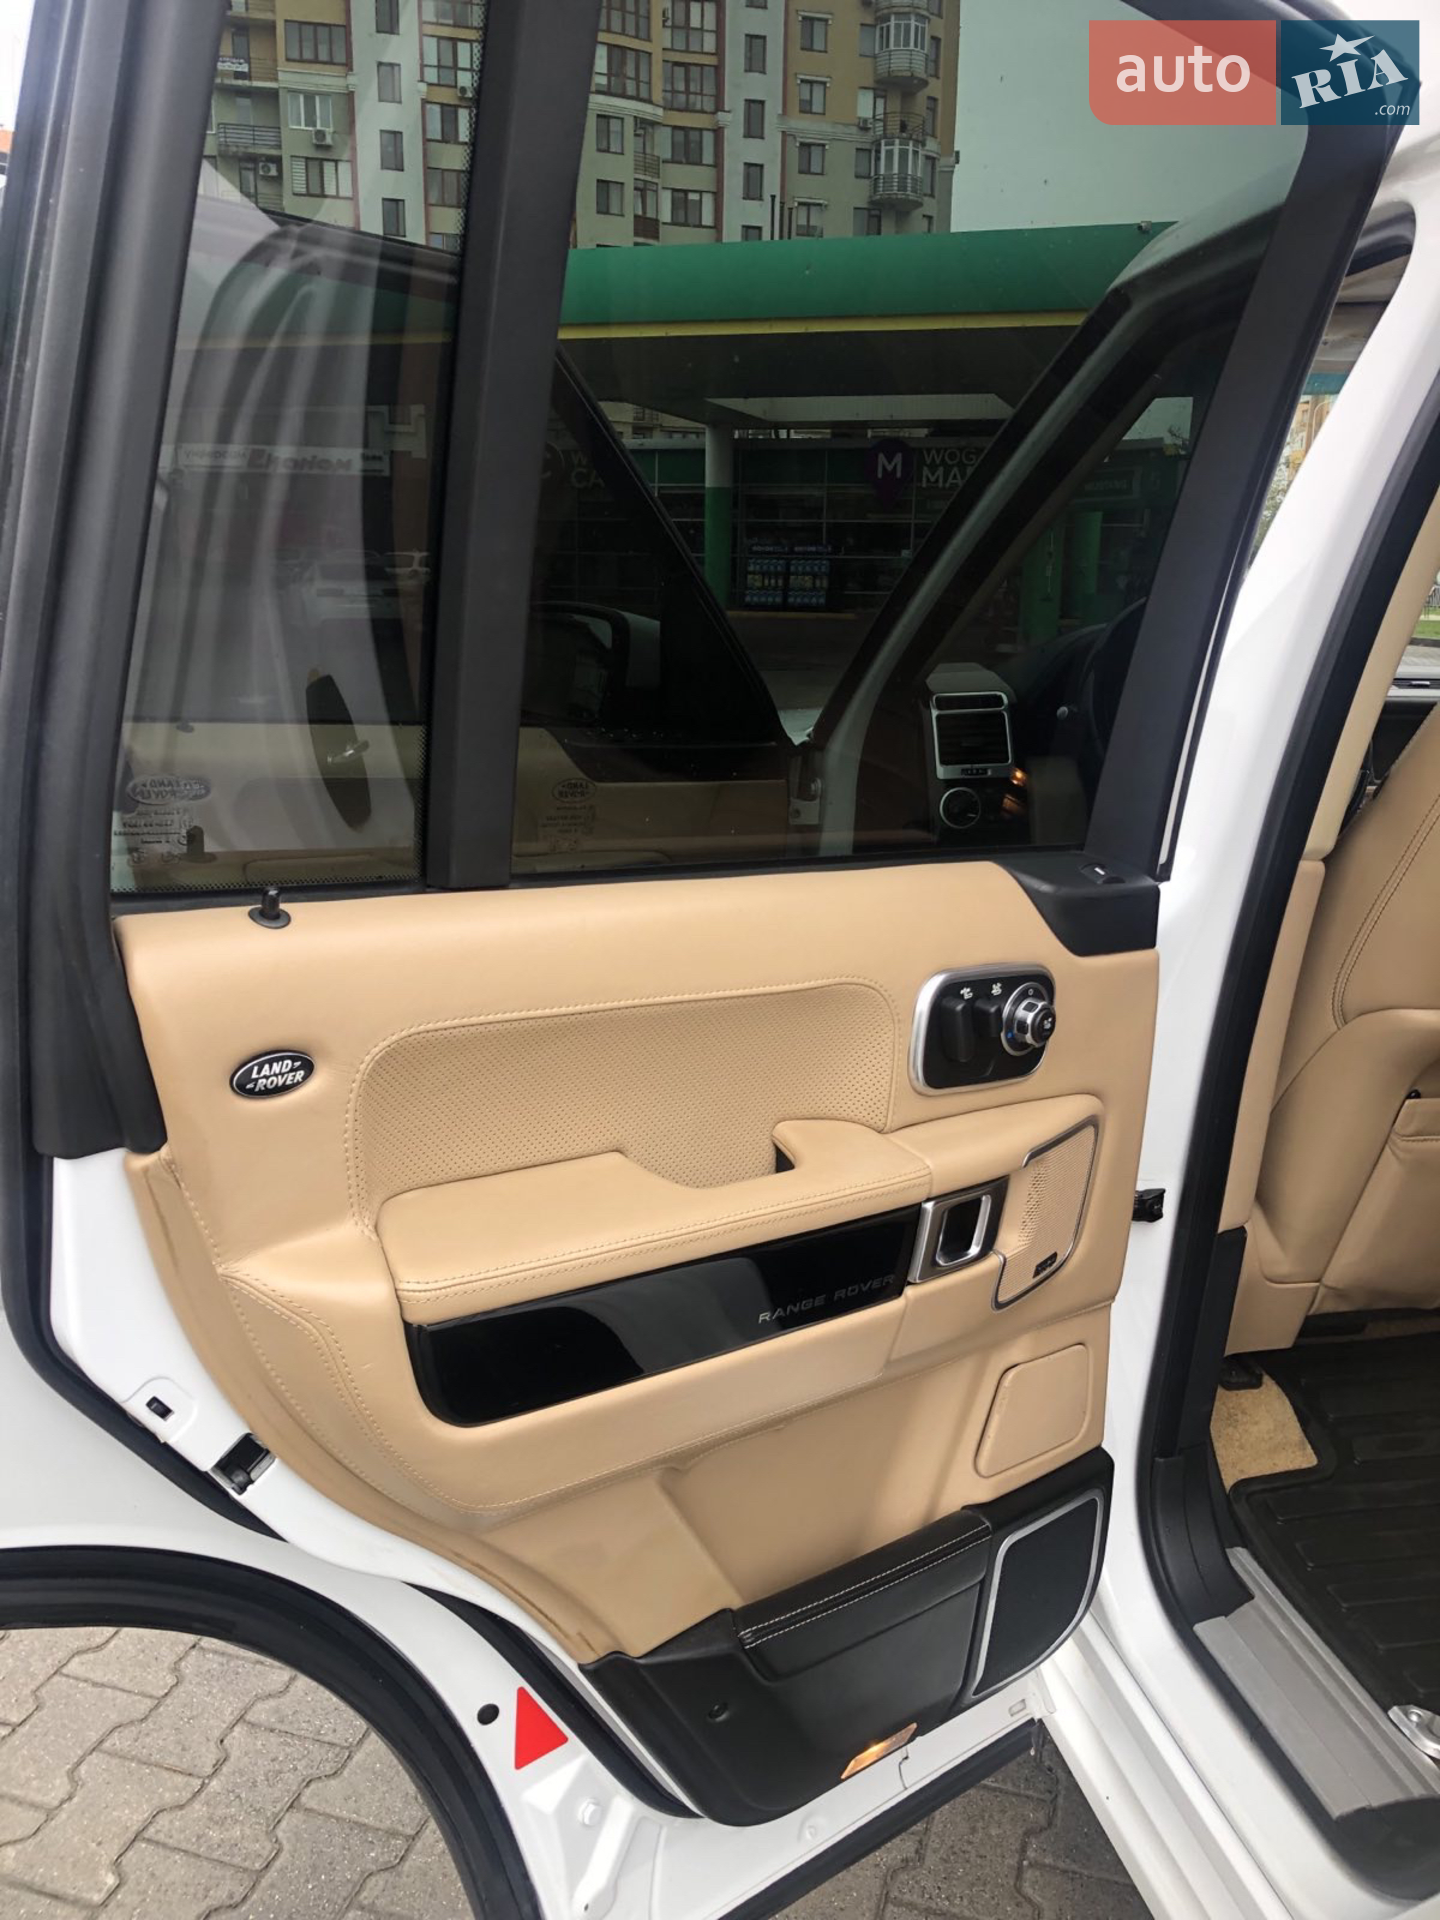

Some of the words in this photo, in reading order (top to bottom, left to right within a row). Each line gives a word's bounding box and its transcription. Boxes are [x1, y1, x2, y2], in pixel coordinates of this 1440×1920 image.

[877, 451, 903, 479] M
[922, 448, 978, 465] WOG
[251, 1060, 292, 1079] LAND
[254, 1070, 305, 1092] ROVER
[758, 1294, 827, 1324] RANGE
[834, 1274, 896, 1302] ROVER
